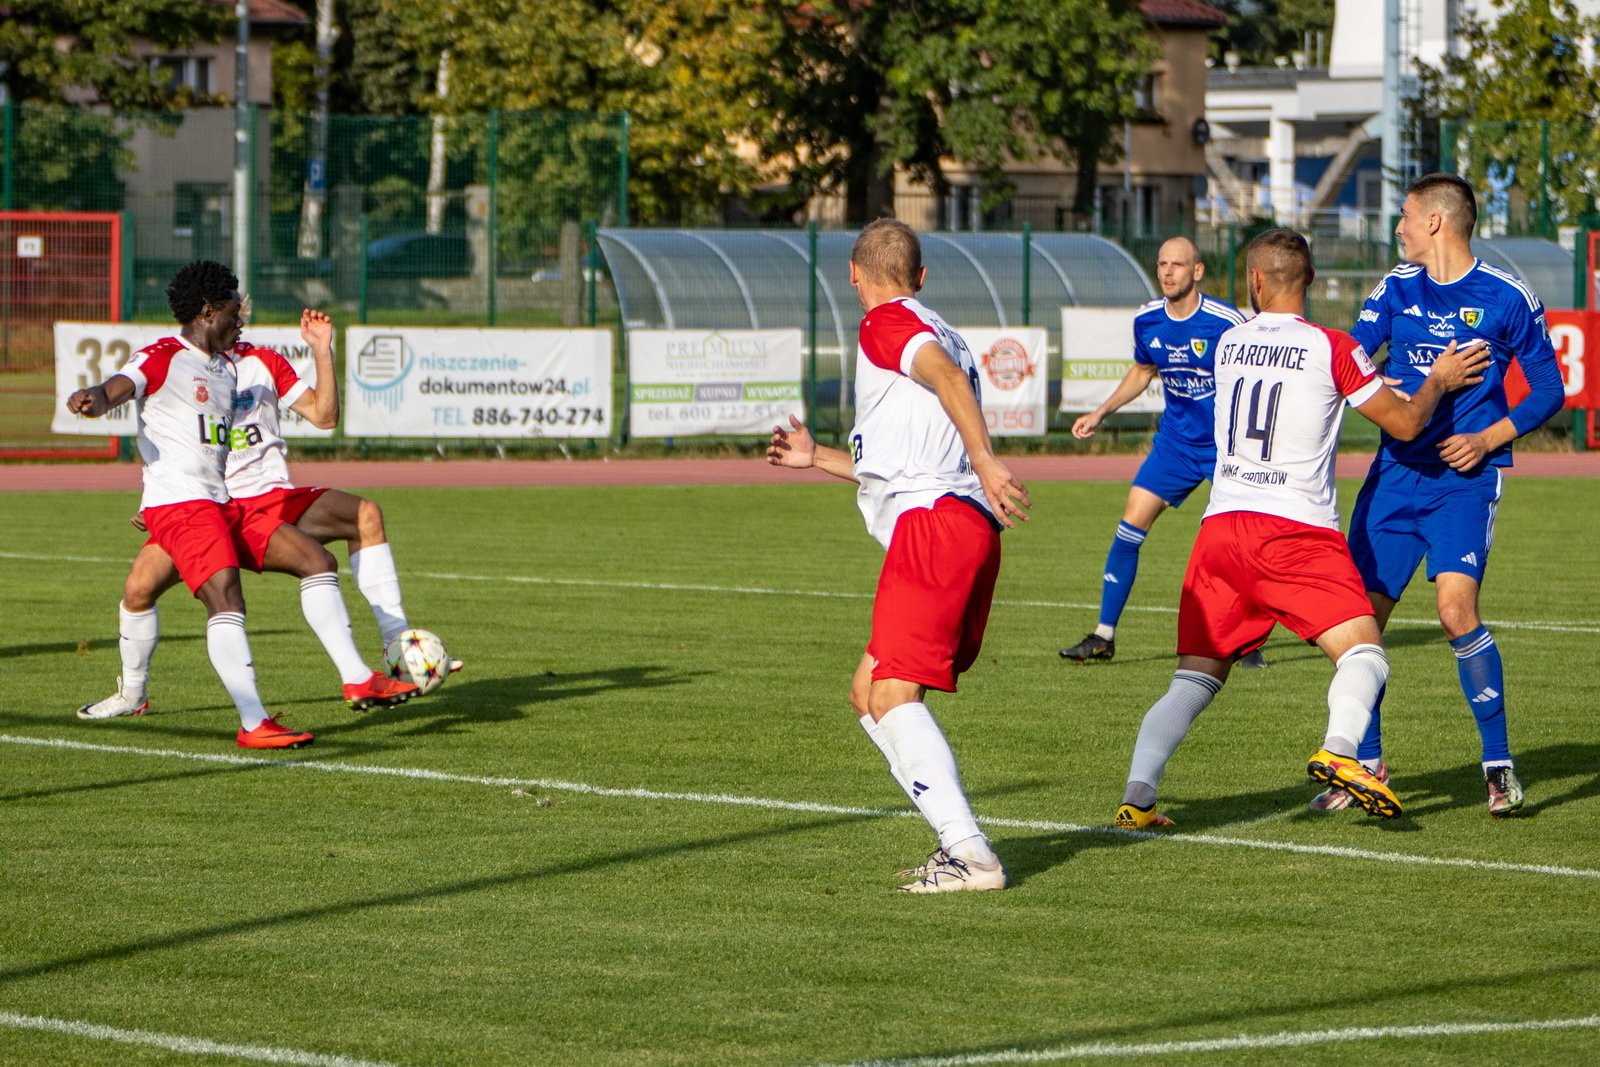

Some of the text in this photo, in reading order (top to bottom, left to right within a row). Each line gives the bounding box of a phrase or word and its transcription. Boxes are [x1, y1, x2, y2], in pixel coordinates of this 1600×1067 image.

[1221, 343, 1309, 371] STAROWICE
[1070, 363, 1135, 378] SPRZED
[419, 377, 590, 397] dokumentow24.pl
[432, 407, 604, 426] TEL 886-740-274
[1227, 376, 1283, 462] 14
